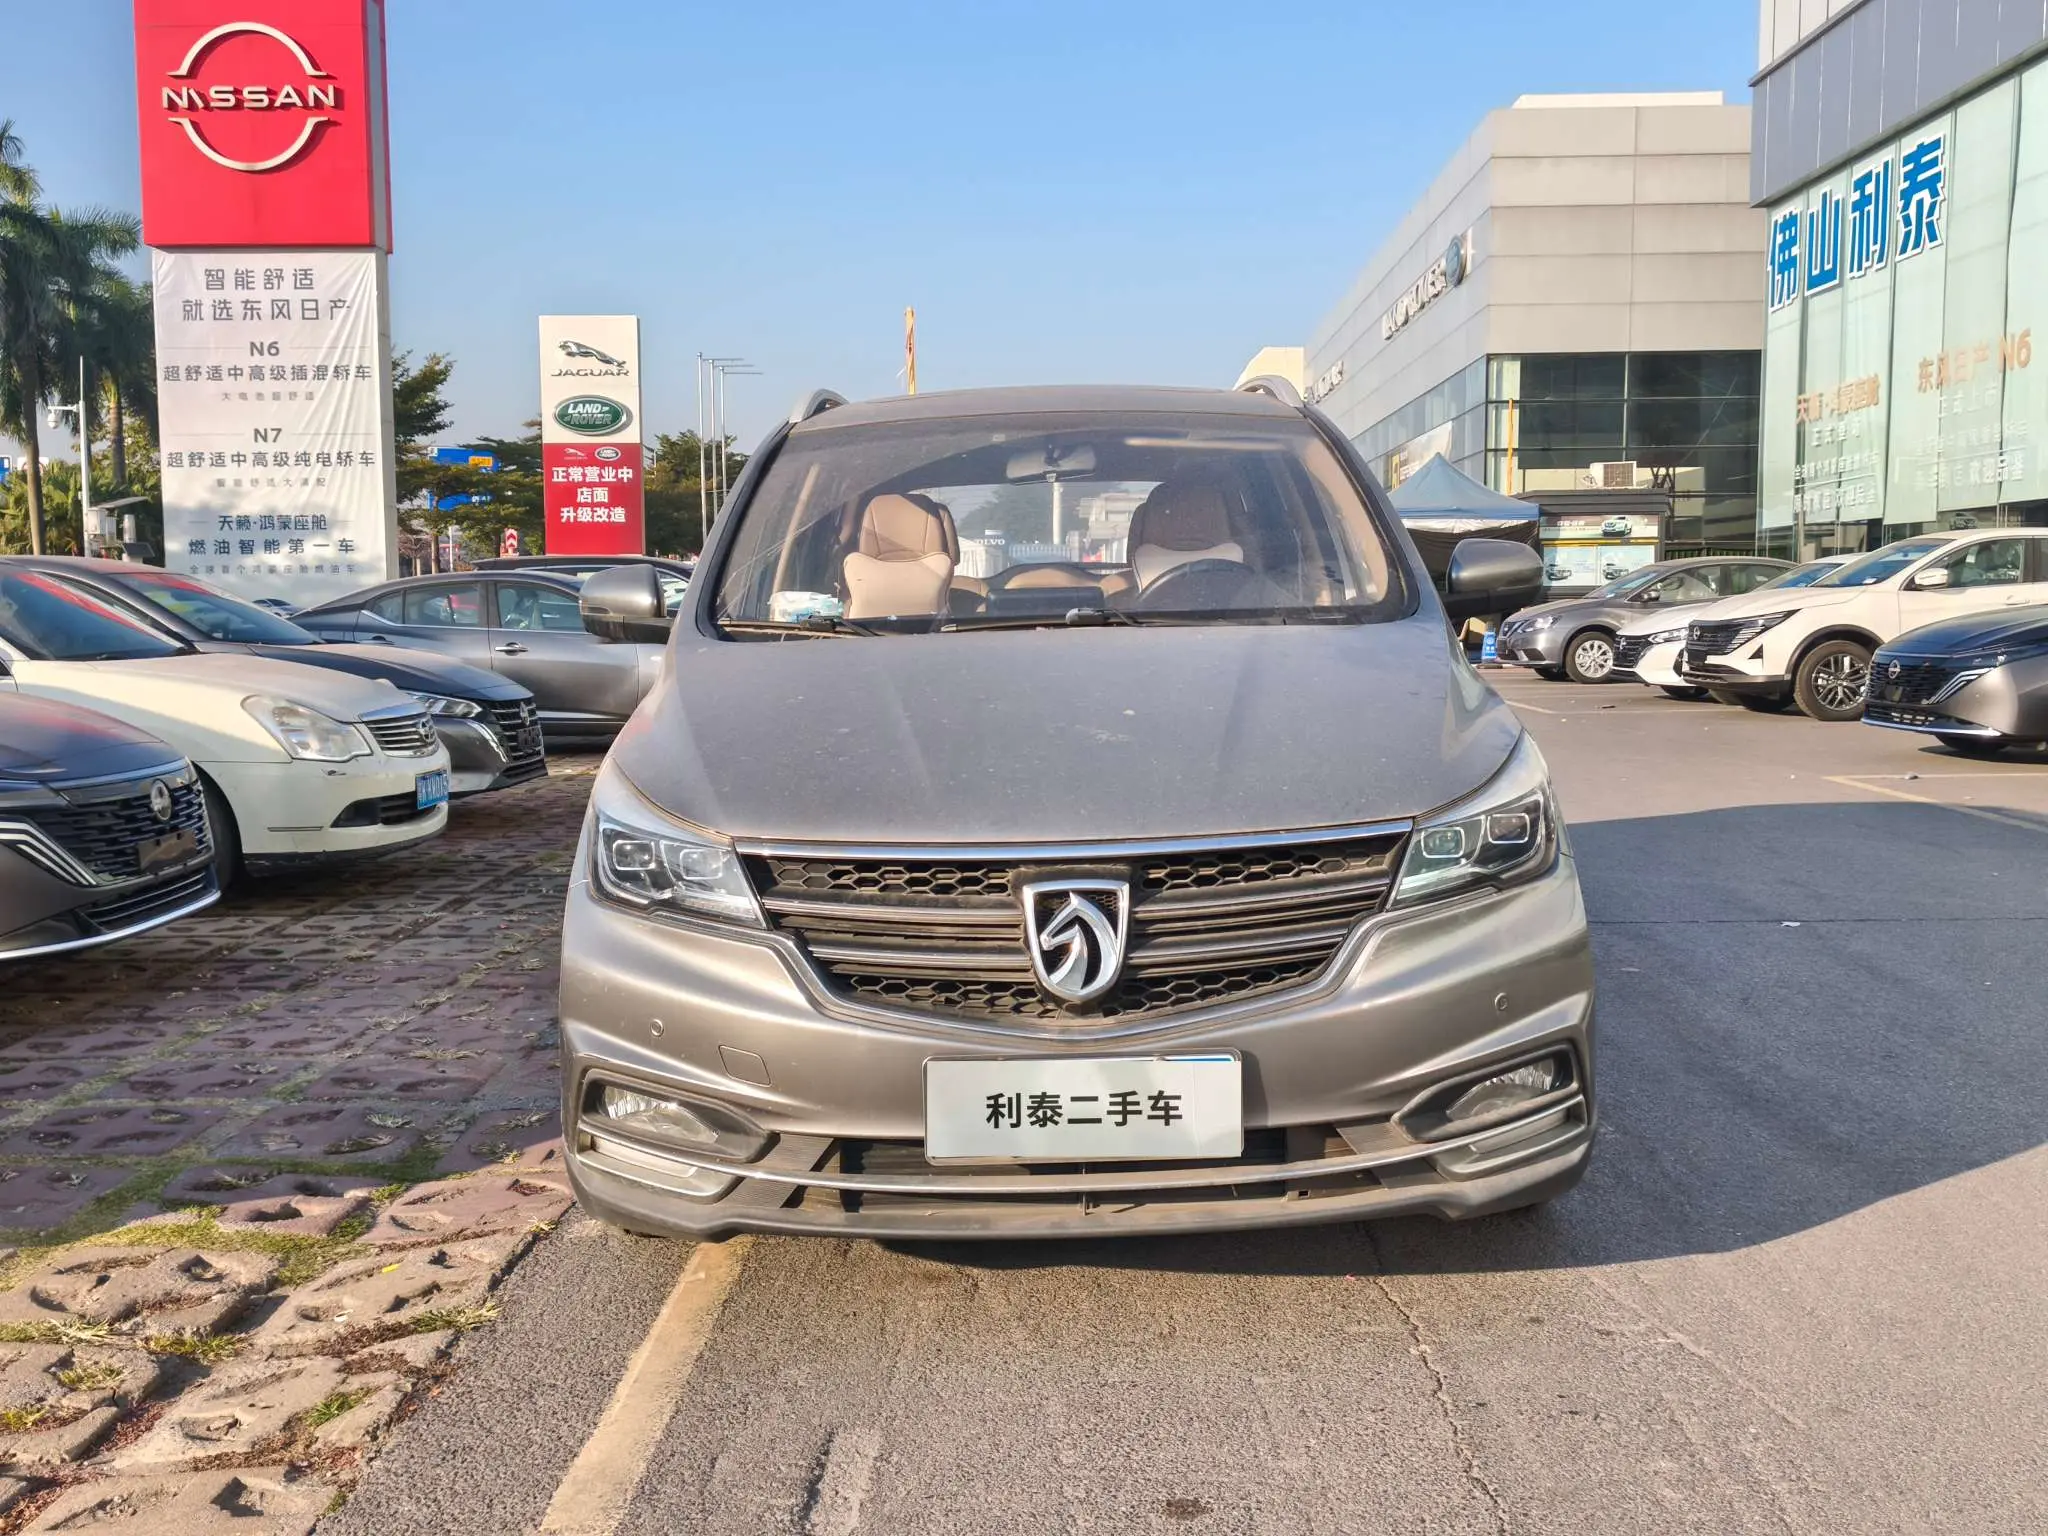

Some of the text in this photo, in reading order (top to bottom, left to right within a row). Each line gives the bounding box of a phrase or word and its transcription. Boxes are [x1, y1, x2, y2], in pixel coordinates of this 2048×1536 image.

[161, 84, 336, 110] NISSAN
[1767, 133, 1945, 313] 佛山利泰
[204, 268, 314, 290] 智能舒适
[181, 298, 351, 321] 就选东风日产
[249, 341, 280, 357] N6
[1997, 328, 2033, 372] N6
[163, 364, 373, 382] 超舒适中高级插混轿车
[551, 368, 630, 377] JAGUAR
[567, 403, 602, 414] LAND
[570, 413, 613, 425] ROVER
[253, 428, 283, 443] N7
[167, 451, 376, 468] 超舒适中高级纯电轿车
[551, 466, 633, 483] 正常营业中
[576, 487, 609, 503] 店面
[218, 514, 328, 531] 天籁·鸿蒙座舱
[560, 506, 627, 523] 升级改造
[188, 538, 356, 556] 燃油智能第一车
[985, 1089, 1183, 1129] 利泰二手车
